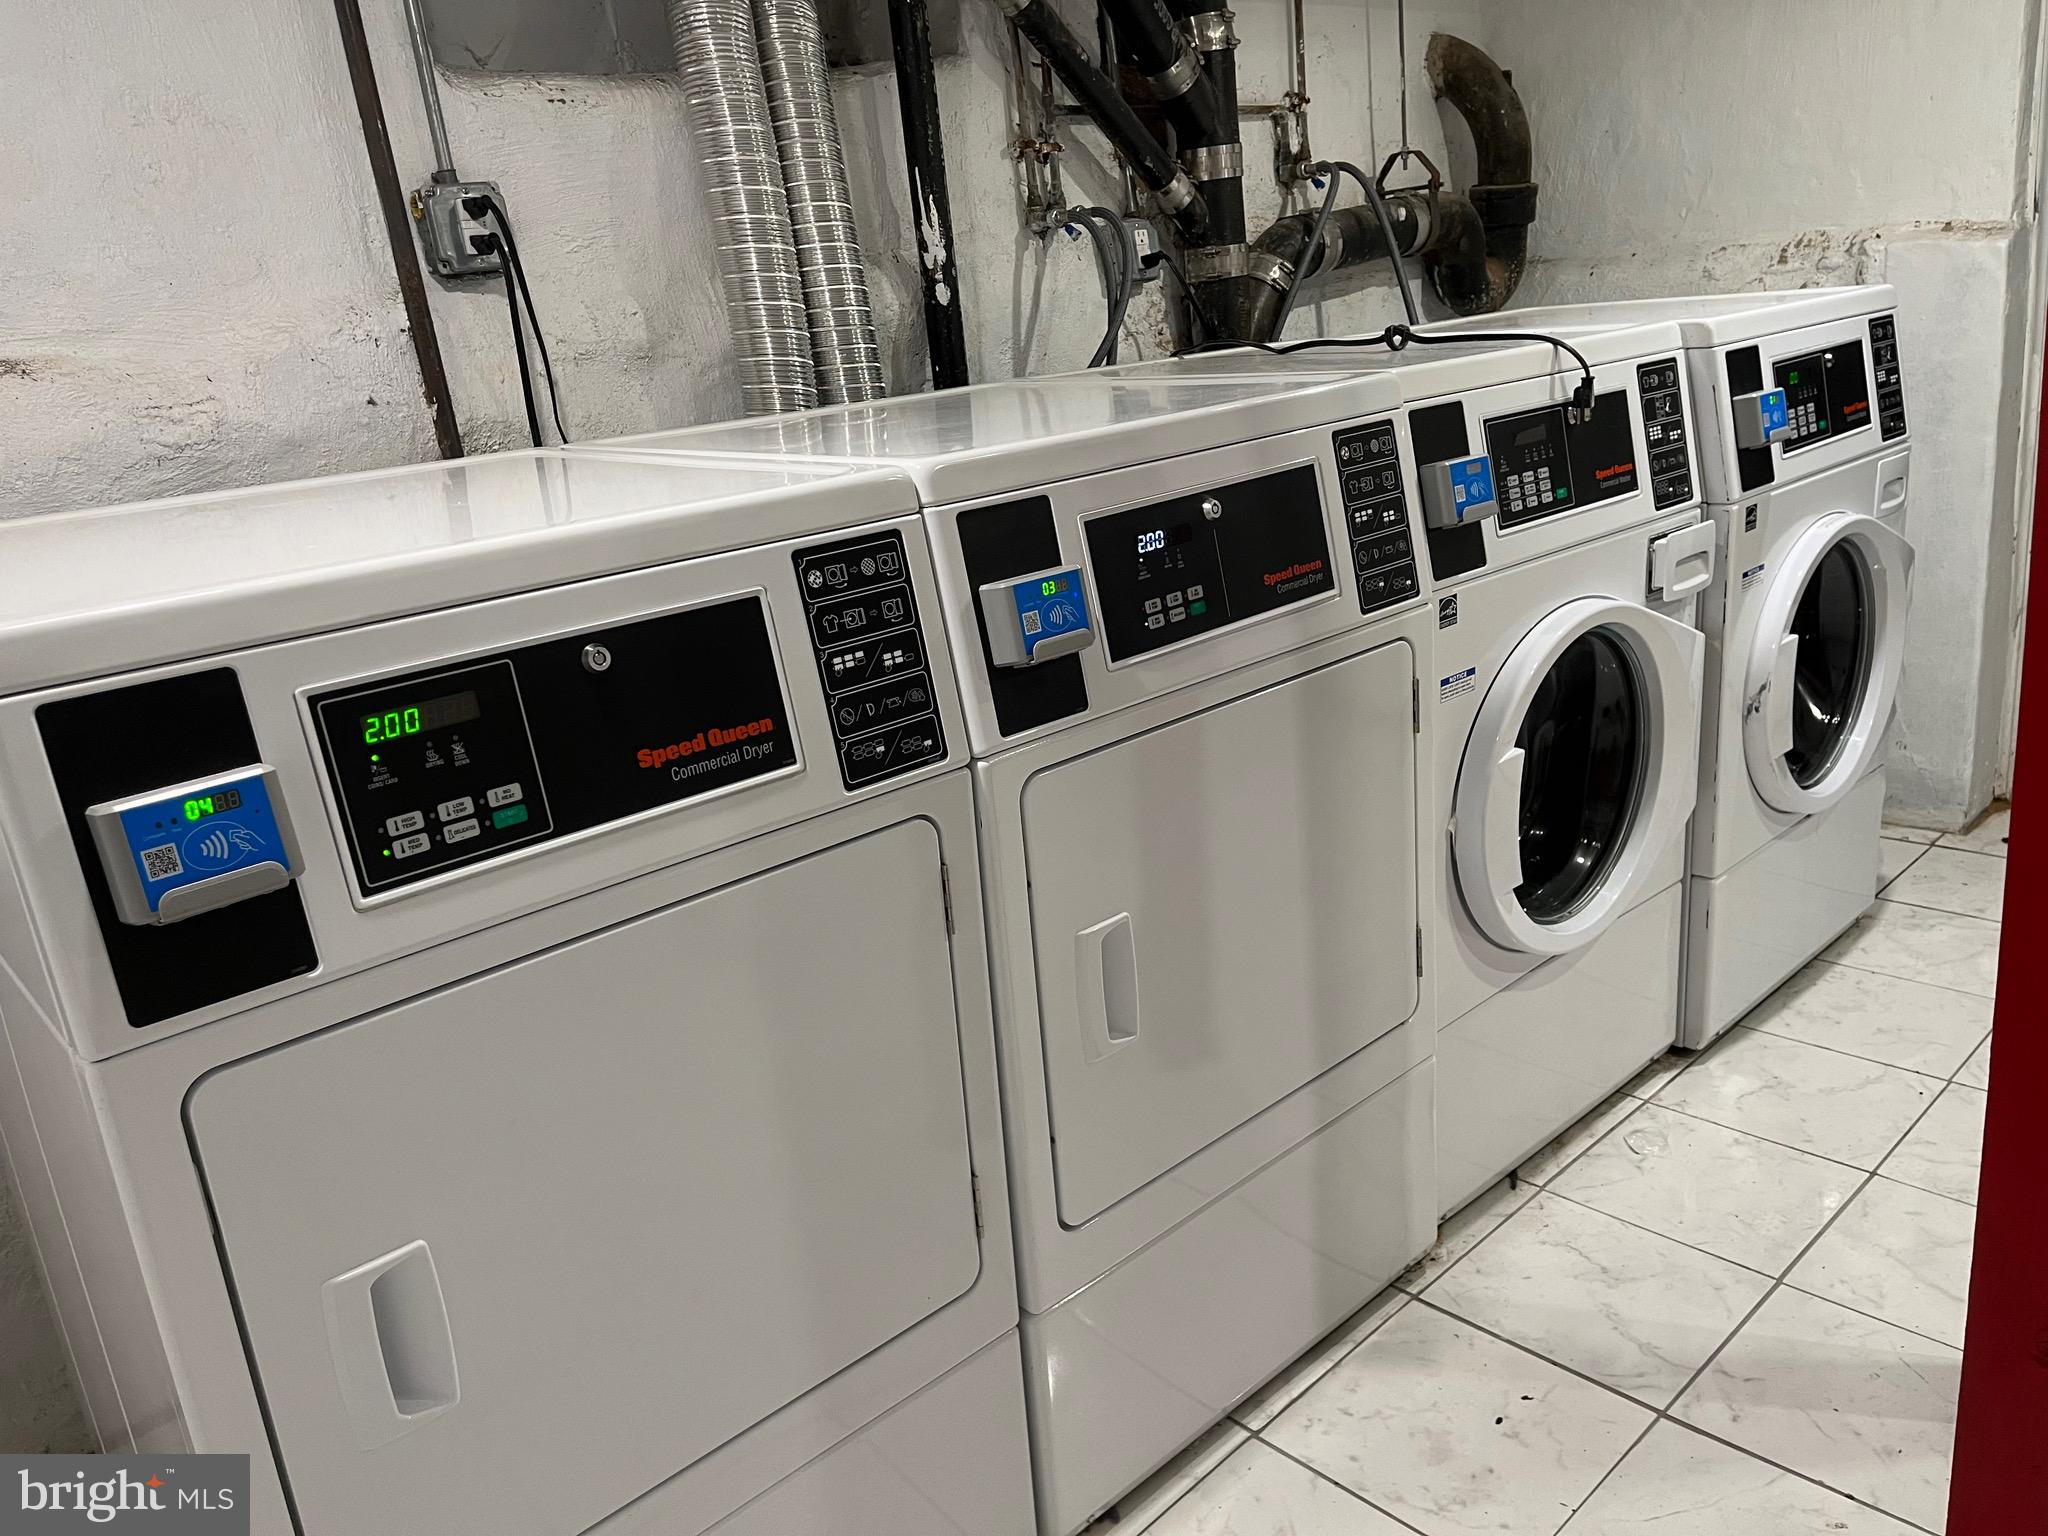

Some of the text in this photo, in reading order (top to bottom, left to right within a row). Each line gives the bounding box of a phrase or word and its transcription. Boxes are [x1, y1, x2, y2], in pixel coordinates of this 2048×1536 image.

[1137, 530, 1165, 554] 2.00
[1263, 560, 1322, 586] Speed Queen
[365, 707, 420, 744] 2.00
[636, 718, 774, 769] Speed Queen
[671, 741, 774, 781] Commercial Dryer
